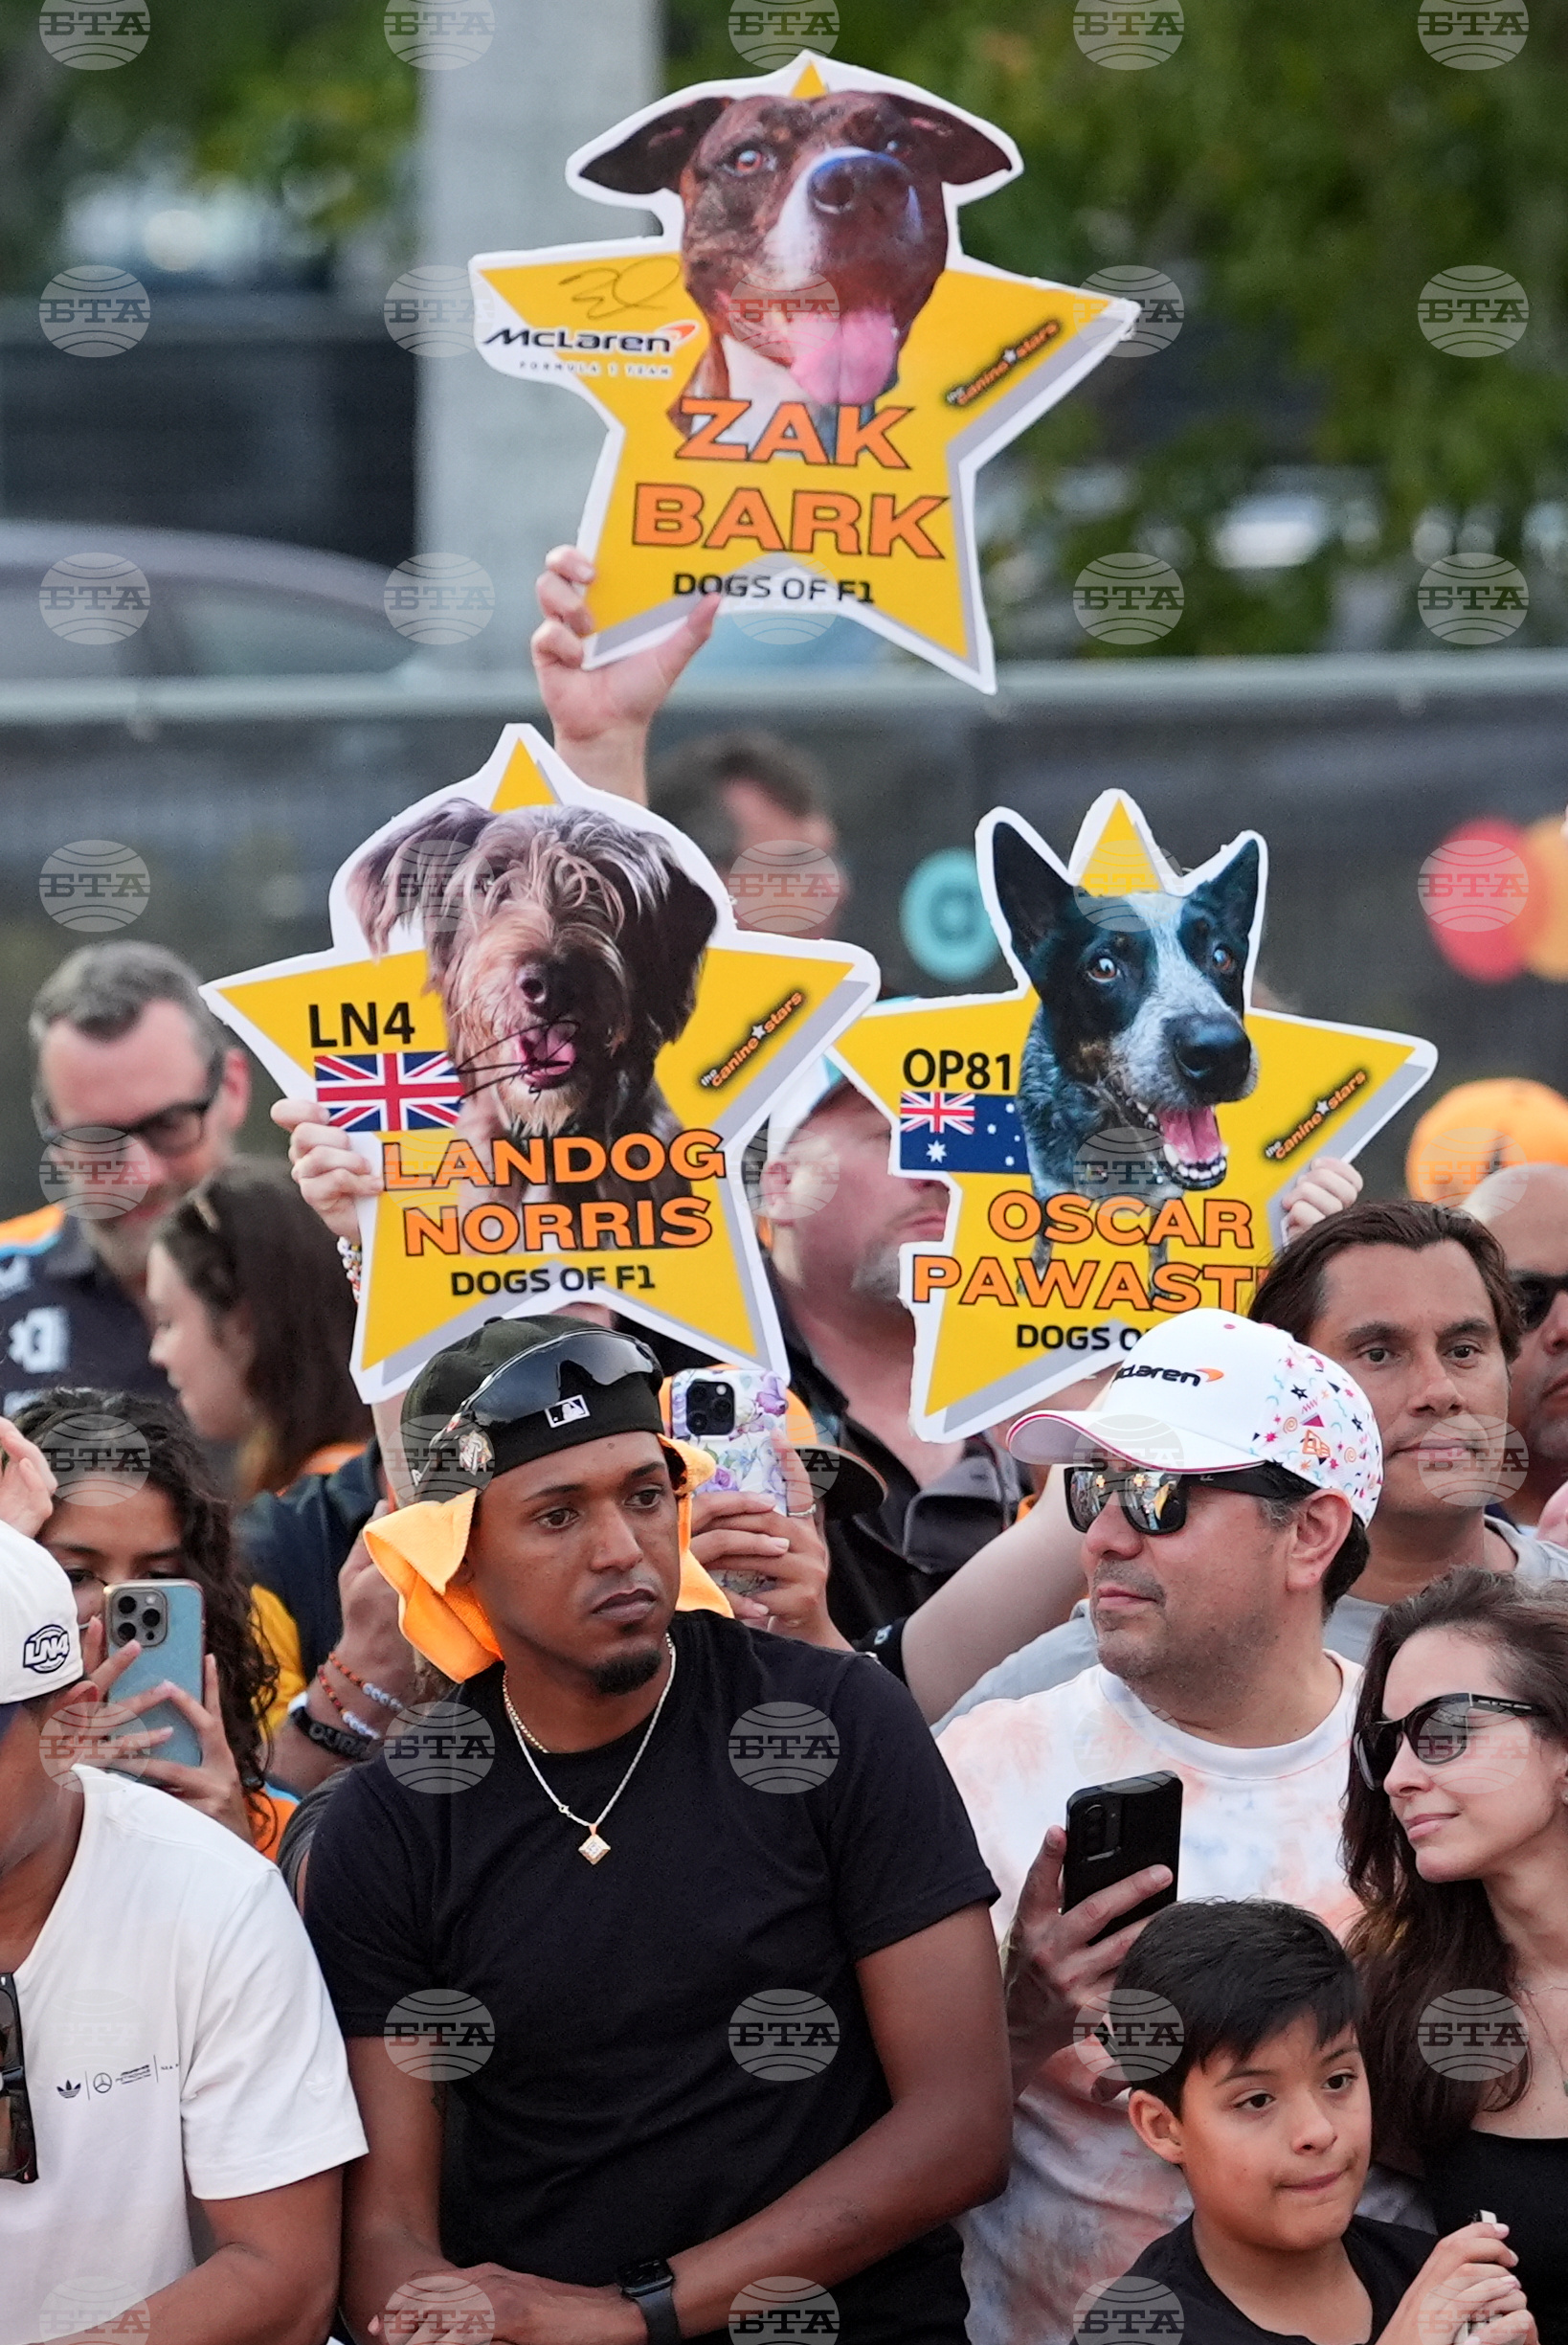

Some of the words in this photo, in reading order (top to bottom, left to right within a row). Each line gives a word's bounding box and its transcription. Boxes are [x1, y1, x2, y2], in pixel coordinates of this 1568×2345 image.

[482, 327, 671, 353] McLaren
[519, 359, 598, 374] FORMULA
[626, 365, 671, 377] TEAM
[675, 396, 914, 469] ZAK
[632, 483, 950, 559] BARK
[673, 573, 771, 598] DOGS
[781, 577, 826, 600] OF
[837, 578, 875, 603] F1
[308, 1002, 415, 1048] LN4
[711, 1037, 759, 1087] canine
[764, 992, 802, 1033] stars
[903, 1047, 1011, 1091] OP81
[1275, 1112, 1323, 1160] canine
[1328, 1071, 1366, 1110] stars
[382, 1128, 727, 1192] LANDOG
[403, 1196, 713, 1256] NORRIS
[987, 1189, 1255, 1249] OSCAR
[450, 1268, 550, 1296] DOGS
[559, 1266, 606, 1292] OF
[616, 1264, 656, 1290] F1
[1017, 1324, 1111, 1351] DOGS
[1119, 1326, 1147, 1351] O
